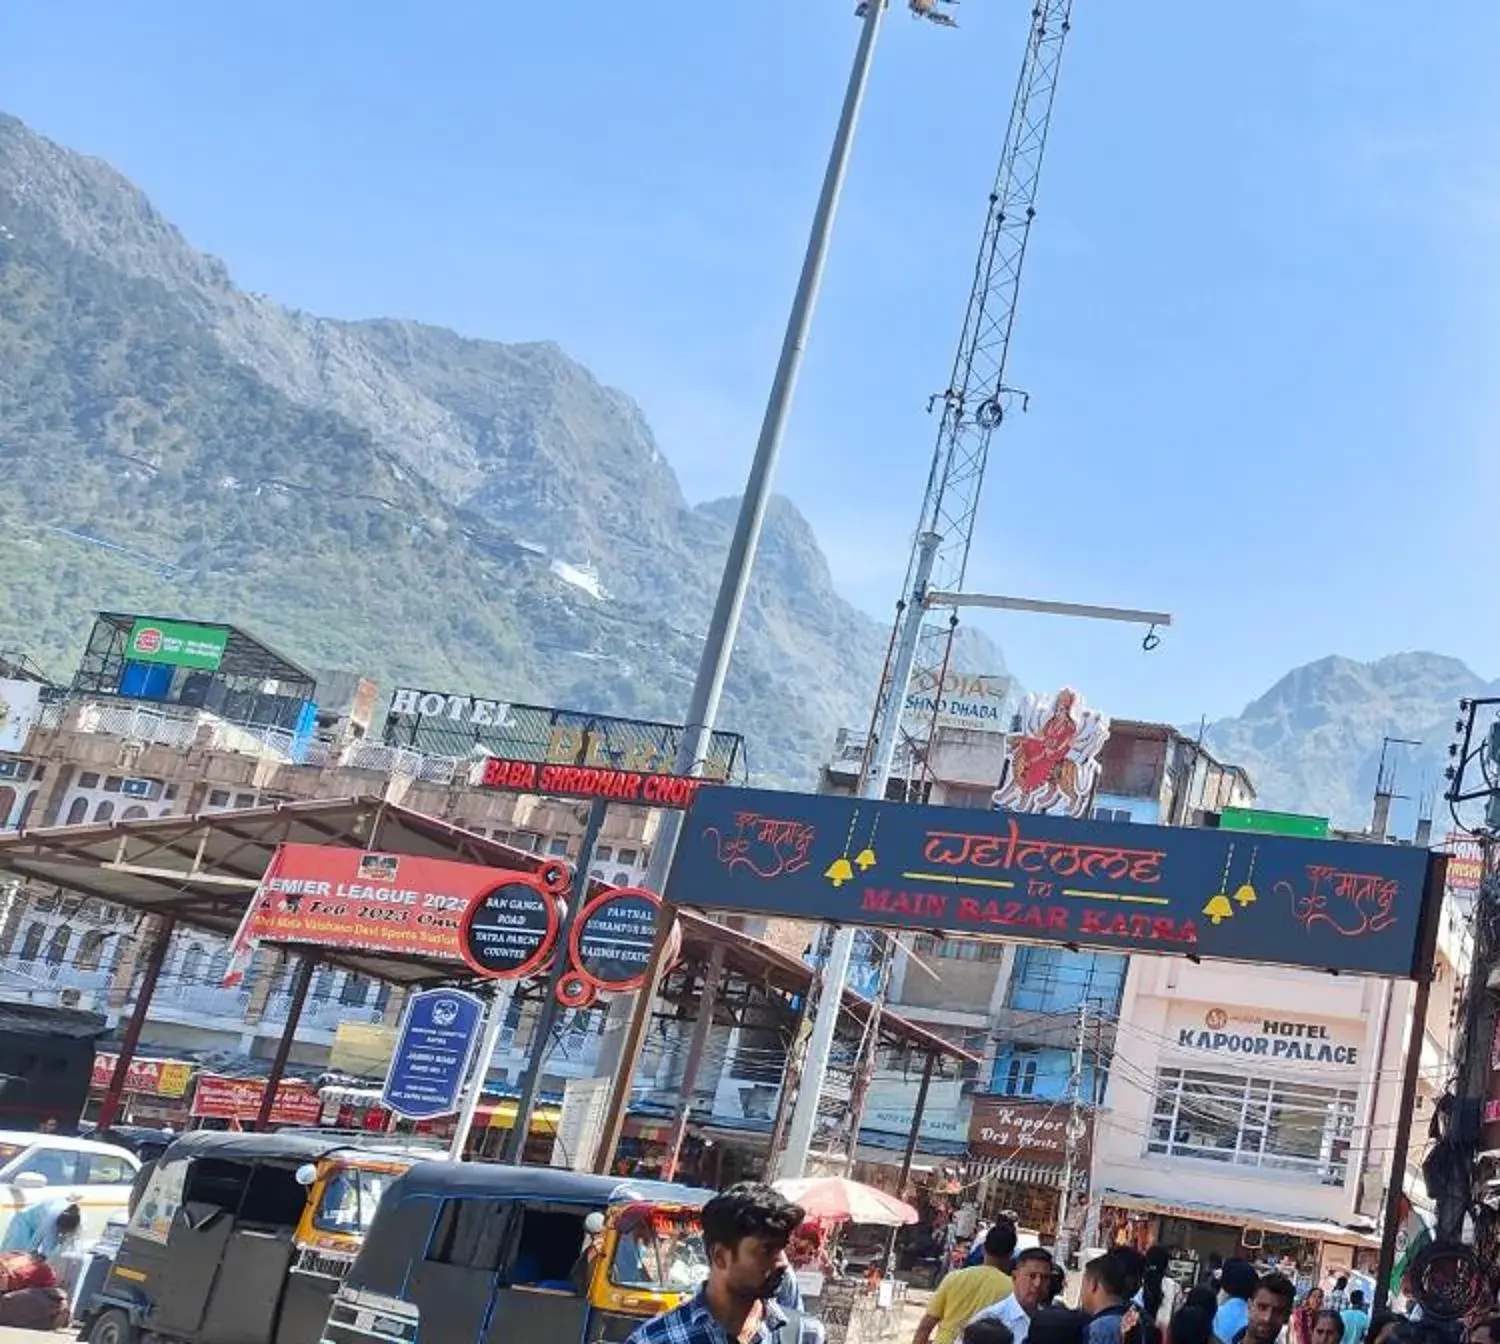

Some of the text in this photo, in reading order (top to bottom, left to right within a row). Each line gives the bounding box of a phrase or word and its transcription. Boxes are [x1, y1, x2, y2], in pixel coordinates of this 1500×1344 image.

[391, 689, 517, 727] HOTEL
[949, 700, 998, 720] DHABA
[483, 757, 535, 789] BABA
[539, 764, 641, 798] SHRIDHAR
[262, 878, 470, 913] EMIER LEAGUE 2023
[509, 898, 545, 912] GANGA
[358, 906, 409, 922] 2023
[496, 912, 528, 926] ROAD
[860, 887, 1198, 943] MAIN BAZAR KATRA
[482, 946, 528, 959] COUNTER
[580, 944, 621, 960] RAILWAY
[1261, 1019, 1330, 1040] HOTEL
[1177, 1028, 1358, 1065] KAPOOR PALACE
[998, 1107, 1064, 1132] Kapoor
[979, 1127, 1058, 1149] Dry Fruits
